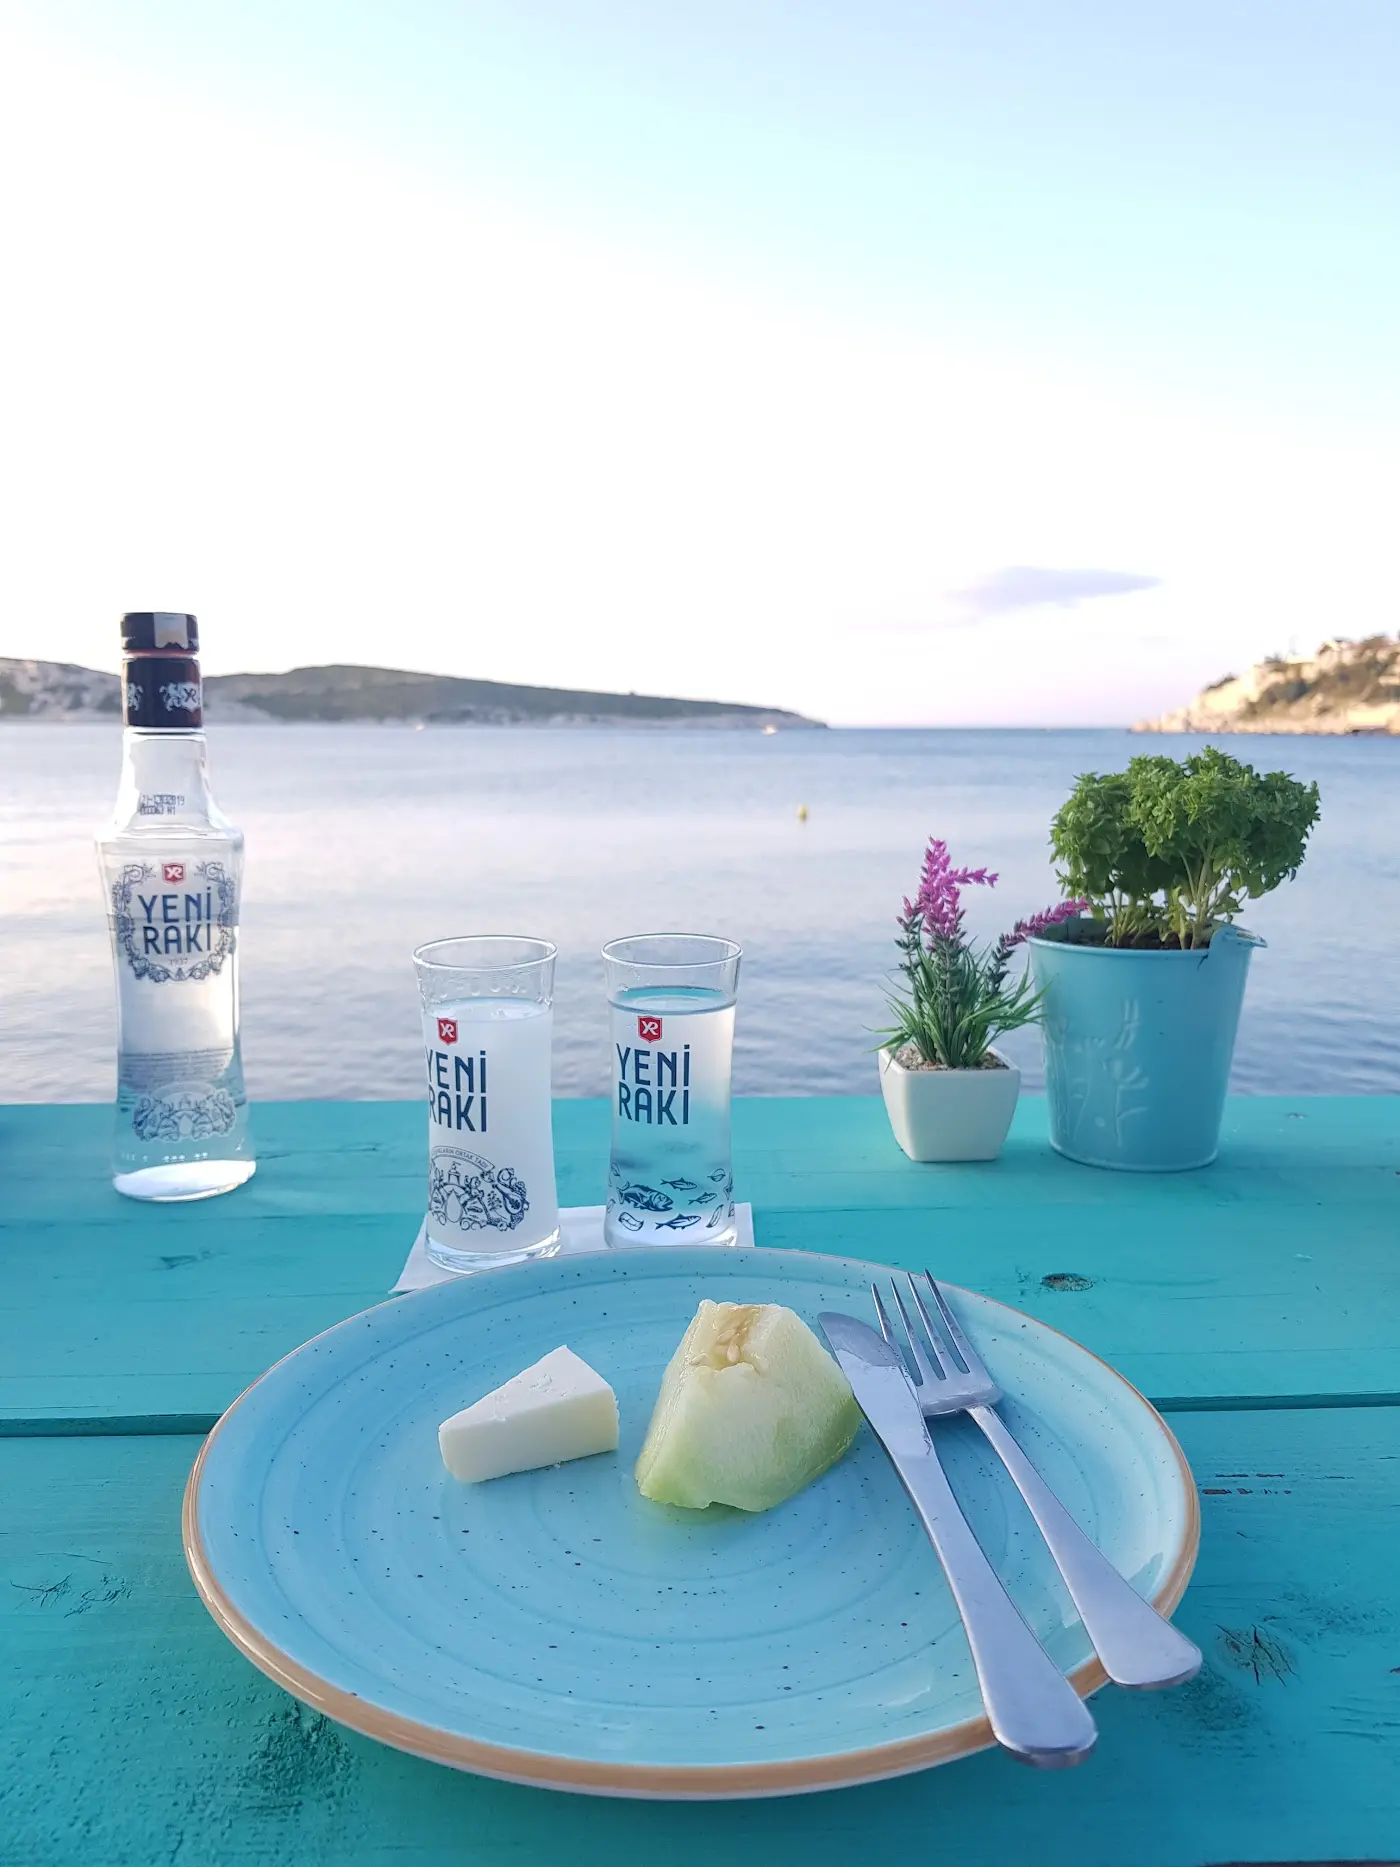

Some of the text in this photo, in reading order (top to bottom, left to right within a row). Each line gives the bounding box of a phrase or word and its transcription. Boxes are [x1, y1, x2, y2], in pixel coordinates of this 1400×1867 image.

[142, 923, 212, 955] RAKI
[428, 1083, 486, 1132] RAKI
[618, 1081, 689, 1125] RAKI
